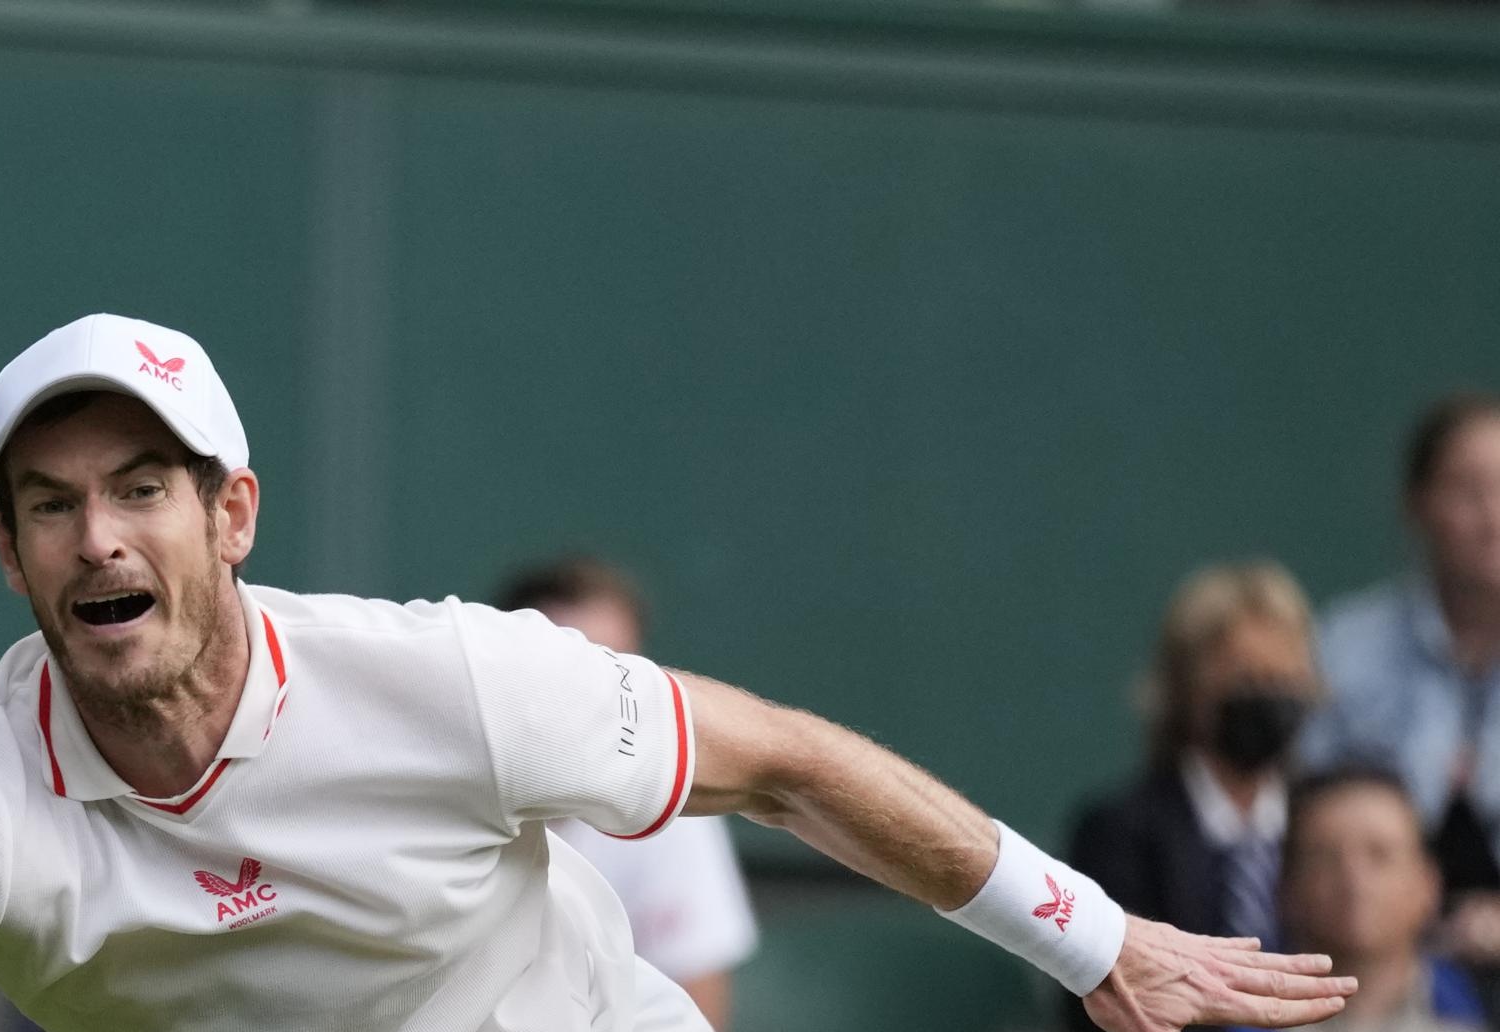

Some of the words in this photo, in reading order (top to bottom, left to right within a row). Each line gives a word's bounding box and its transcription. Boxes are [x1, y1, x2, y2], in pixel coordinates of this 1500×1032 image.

[139, 362, 182, 391] AMC
[217, 884, 277, 922] AMC
[228, 905, 278, 930] WOOLMARK
[1055, 888, 1075, 932] AMC
